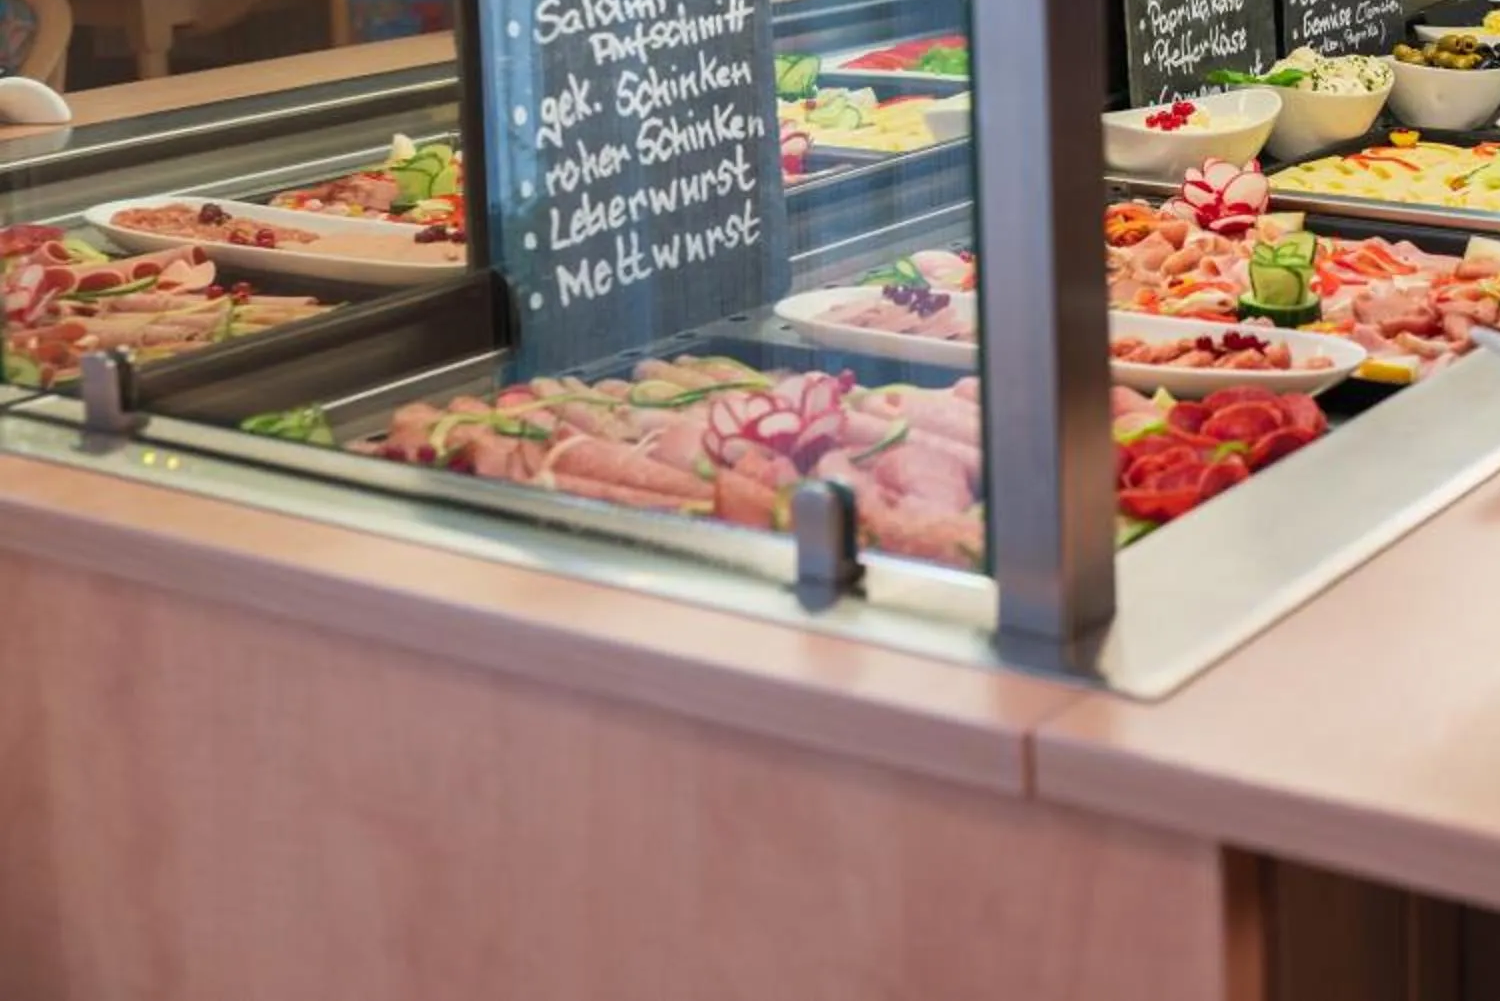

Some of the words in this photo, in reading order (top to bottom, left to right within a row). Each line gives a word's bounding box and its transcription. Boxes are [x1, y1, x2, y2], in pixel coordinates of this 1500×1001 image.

[1303, 2, 1352, 39] Gemüse
[536, 72, 603, 149] gek.
[545, 139, 632, 197] roher
[550, 143, 756, 251] Leberwurst
[556, 199, 762, 307] Mettwurst
